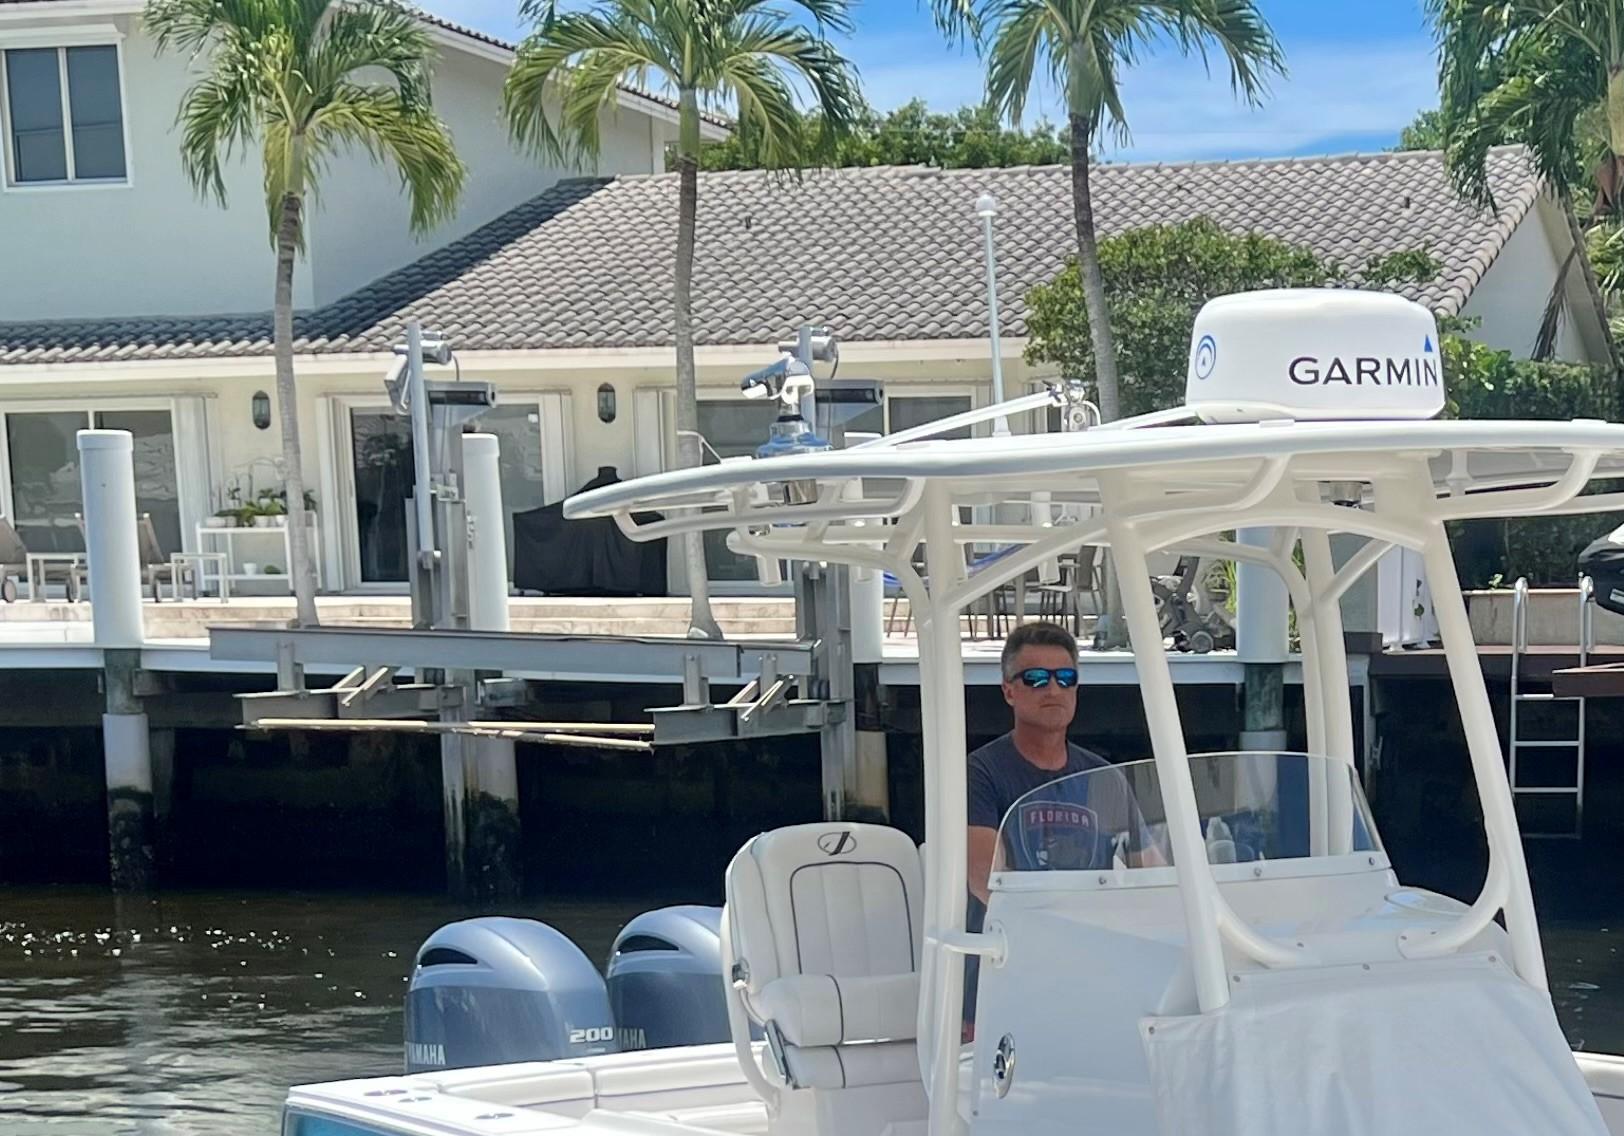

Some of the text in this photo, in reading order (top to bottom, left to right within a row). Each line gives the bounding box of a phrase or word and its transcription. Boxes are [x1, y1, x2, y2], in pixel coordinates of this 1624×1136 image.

[1288, 355, 1439, 387] GARMIN
[1029, 809, 1090, 828] FLORIDA
[569, 1026, 614, 1043] 200
